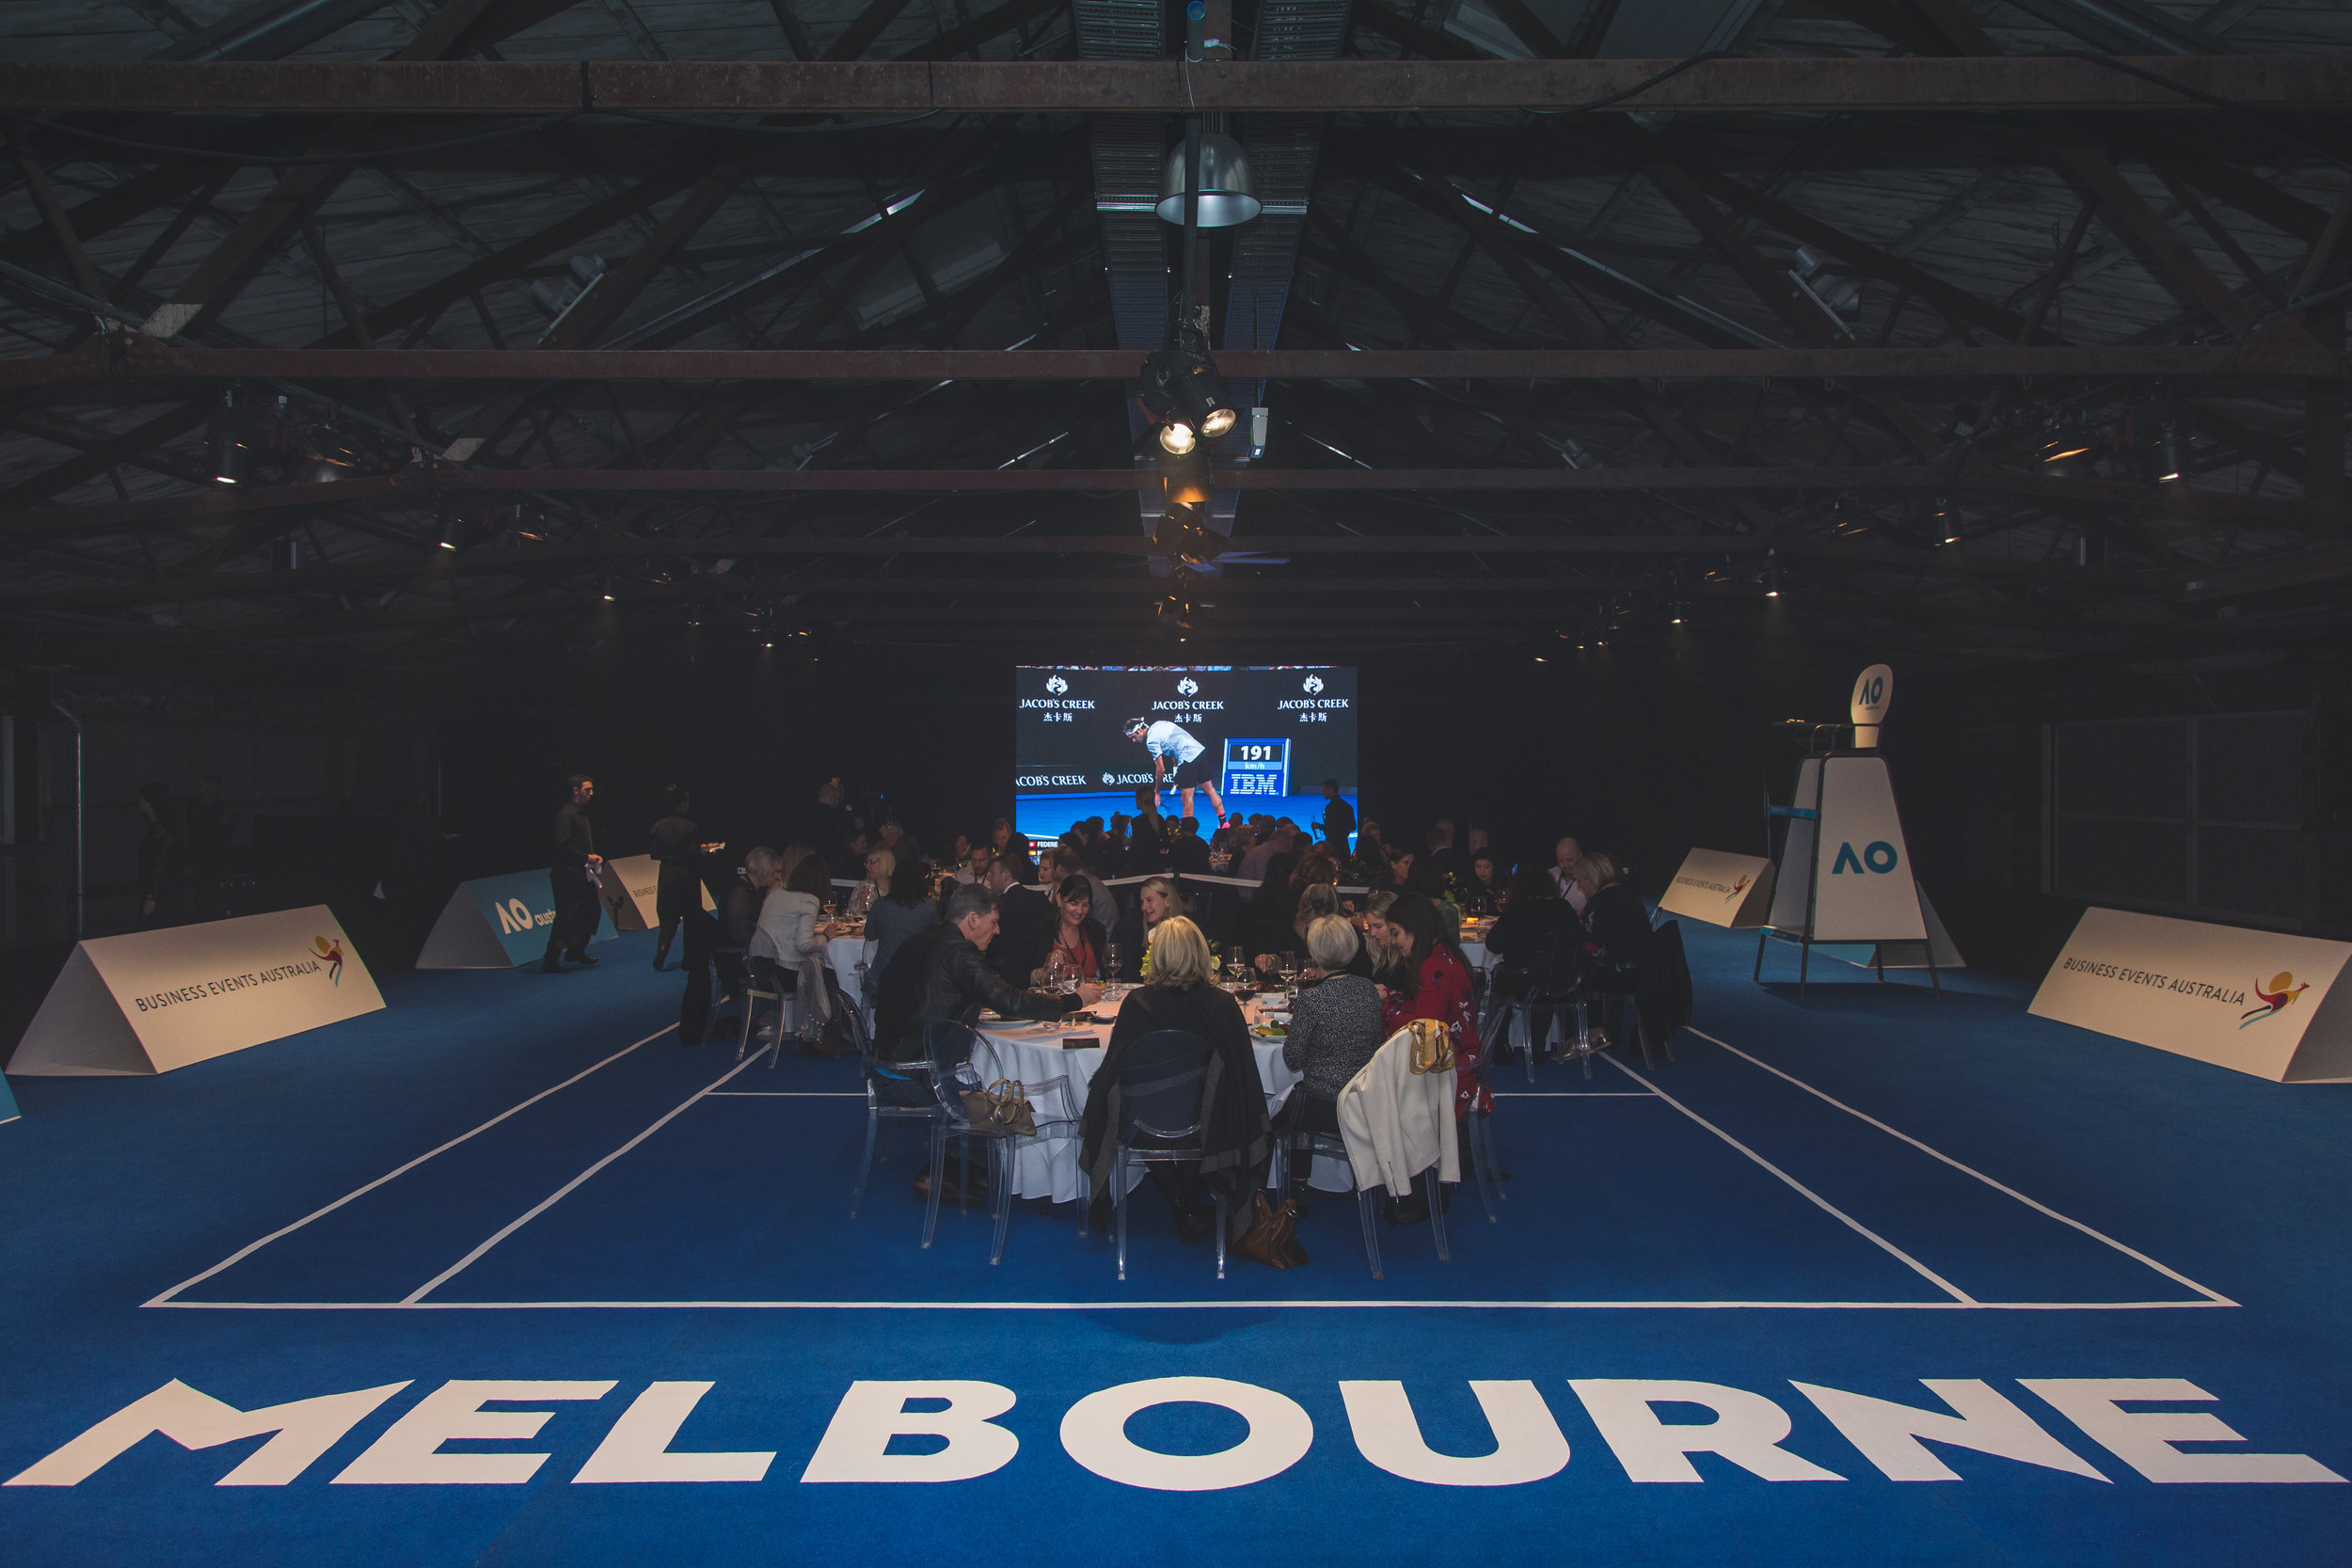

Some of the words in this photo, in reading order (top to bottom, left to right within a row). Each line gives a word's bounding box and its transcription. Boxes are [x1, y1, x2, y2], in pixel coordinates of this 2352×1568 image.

[1019, 698, 1060, 709] JACOB'S
[1062, 699, 1095, 709] CREEK
[1151, 700, 1190, 710] JACOB'S
[1192, 700, 1224, 710] CREEK
[1277, 698, 1315, 710] JACOB'S
[1317, 698, 1349, 708] CREEK
[1042, 712, 1073, 722] 杰卡斯
[1174, 713, 1202, 723] 杰卡斯
[1299, 712, 1327, 722] 杰卡斯
[1241, 745, 1271, 760] 191
[1051, 774, 1087, 786] CREEK
[1117, 772, 1154, 785] JACOB'S
[1231, 773, 1278, 796] IBM
[1832, 841, 1898, 874] AO
[135, 984, 208, 1012] BUSINESS
[208, 973, 259, 996] EVENTS
[259, 960, 322, 985] AUSTRALIA
[2063, 958, 2118, 978] BUSINESS
[2118, 968, 2168, 989] EVENTS
[2168, 978, 2246, 1006] AUSTRALIA
[2, 1376, 2349, 1491] MELBOURNE
